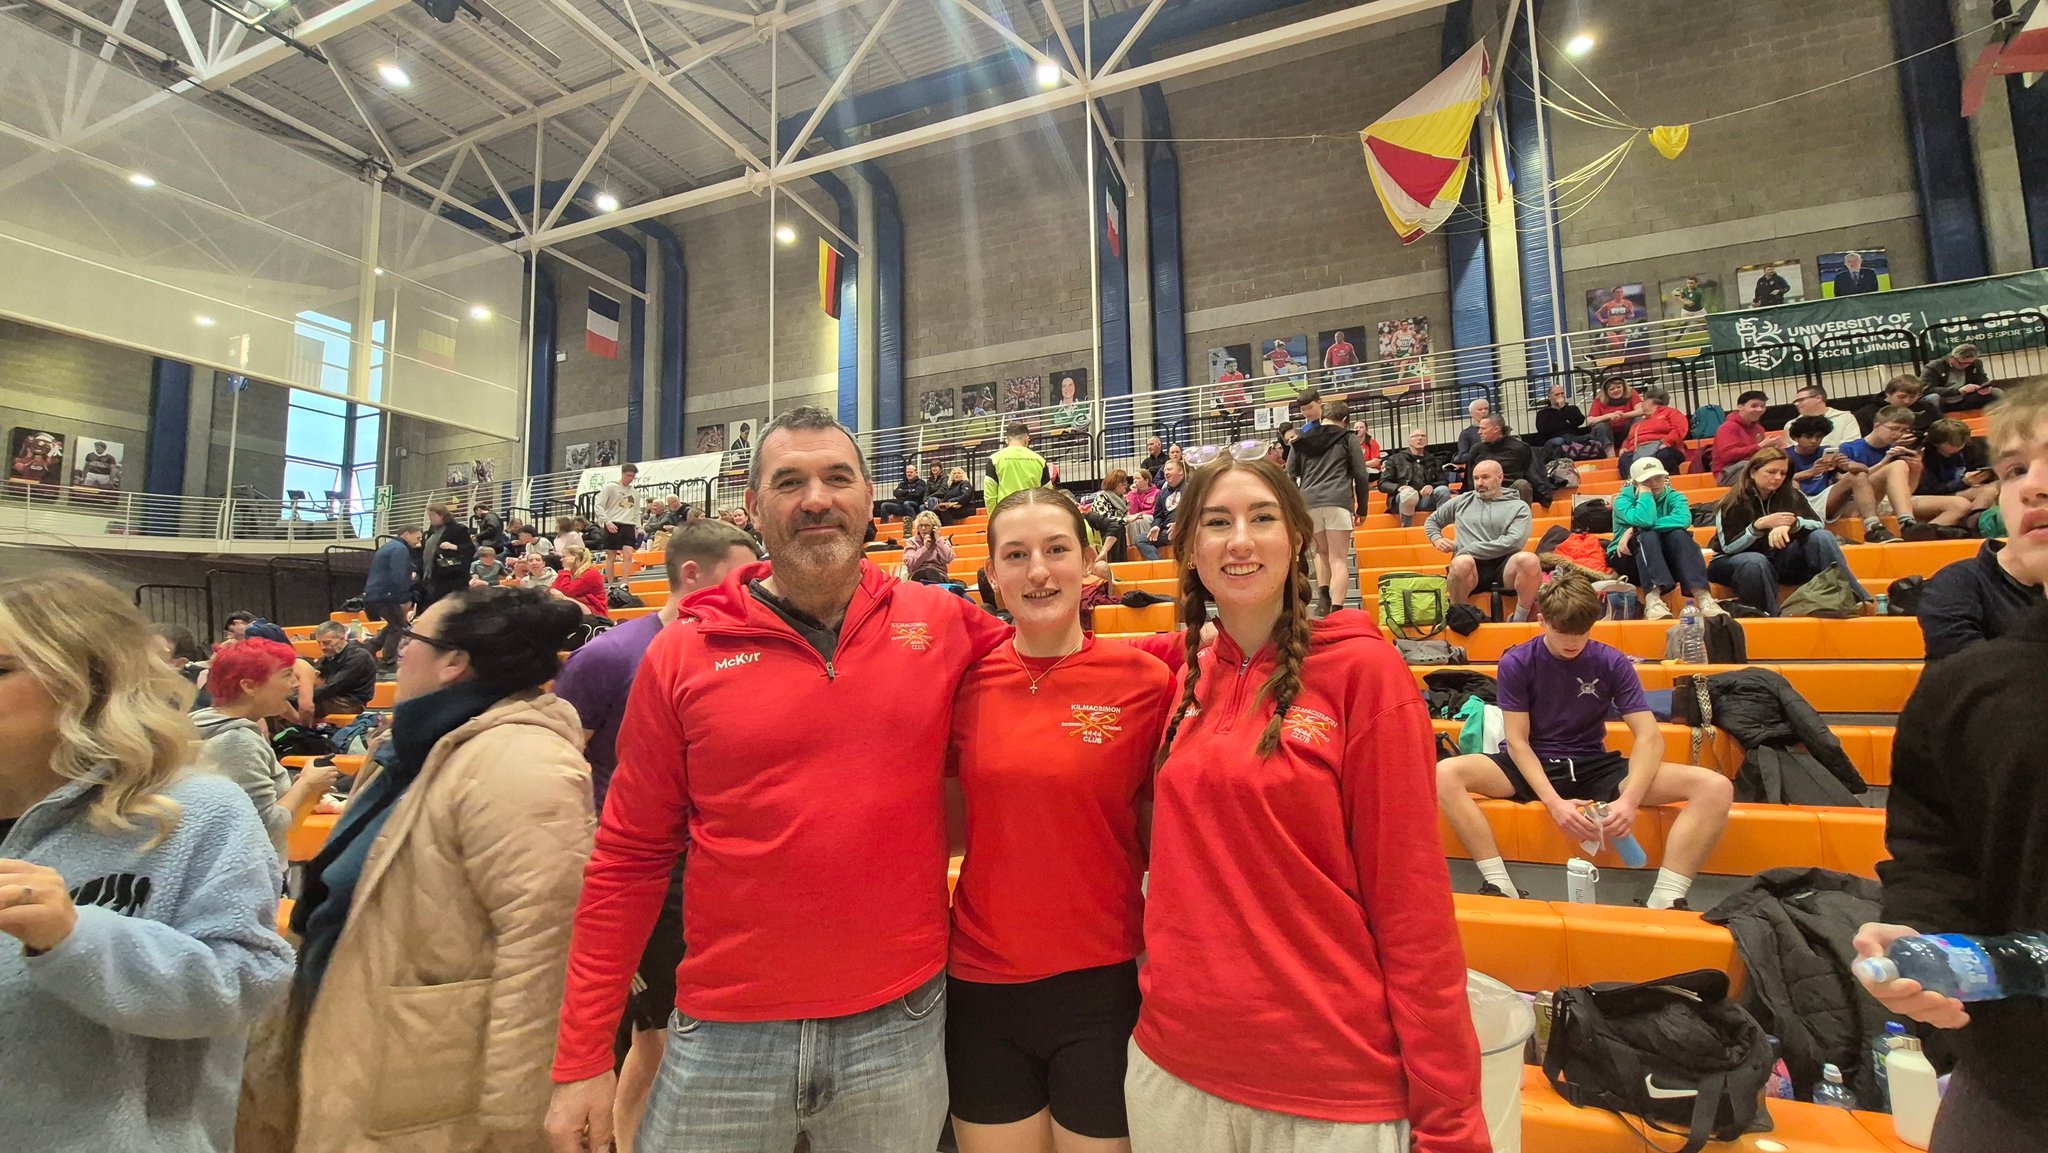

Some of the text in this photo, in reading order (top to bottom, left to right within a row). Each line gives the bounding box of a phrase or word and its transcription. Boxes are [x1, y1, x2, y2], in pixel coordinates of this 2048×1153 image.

[1787, 312, 1911, 337] UNIVERSITY OF
[1944, 332, 1994, 344] IREANDS
[1995, 326, 2033, 338] SPORS
[1793, 348, 1852, 362] OLSCOIL
[1083, 736, 1102, 744] CLUB
[1291, 731, 1310, 744] CLUB
